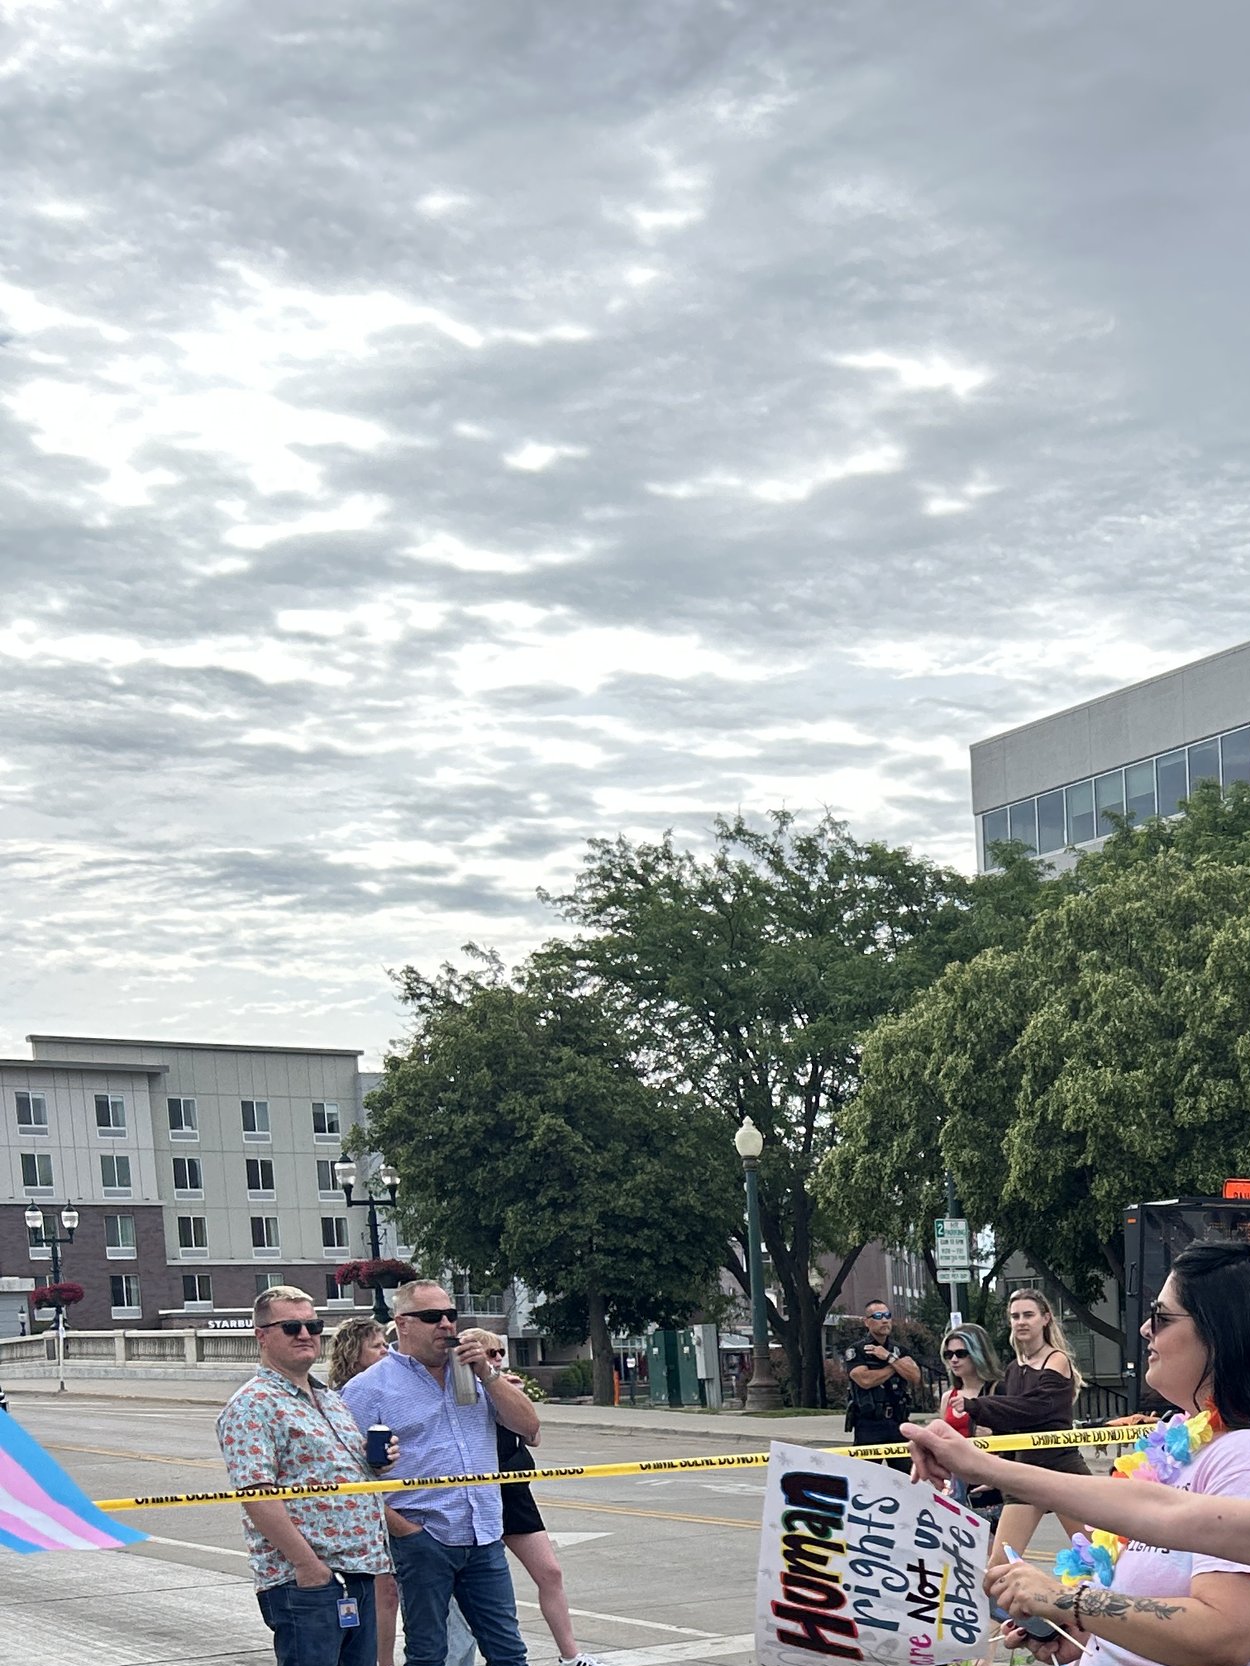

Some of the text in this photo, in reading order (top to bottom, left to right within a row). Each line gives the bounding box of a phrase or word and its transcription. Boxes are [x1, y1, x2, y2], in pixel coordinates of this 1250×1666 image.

[937, 1223, 944, 1235] 2
[208, 1319, 253, 1329] STARBU
[771, 1471, 865, 1661] Human
[842, 1493, 910, 1632] rights
[905, 1508, 945, 1666] are Not up
